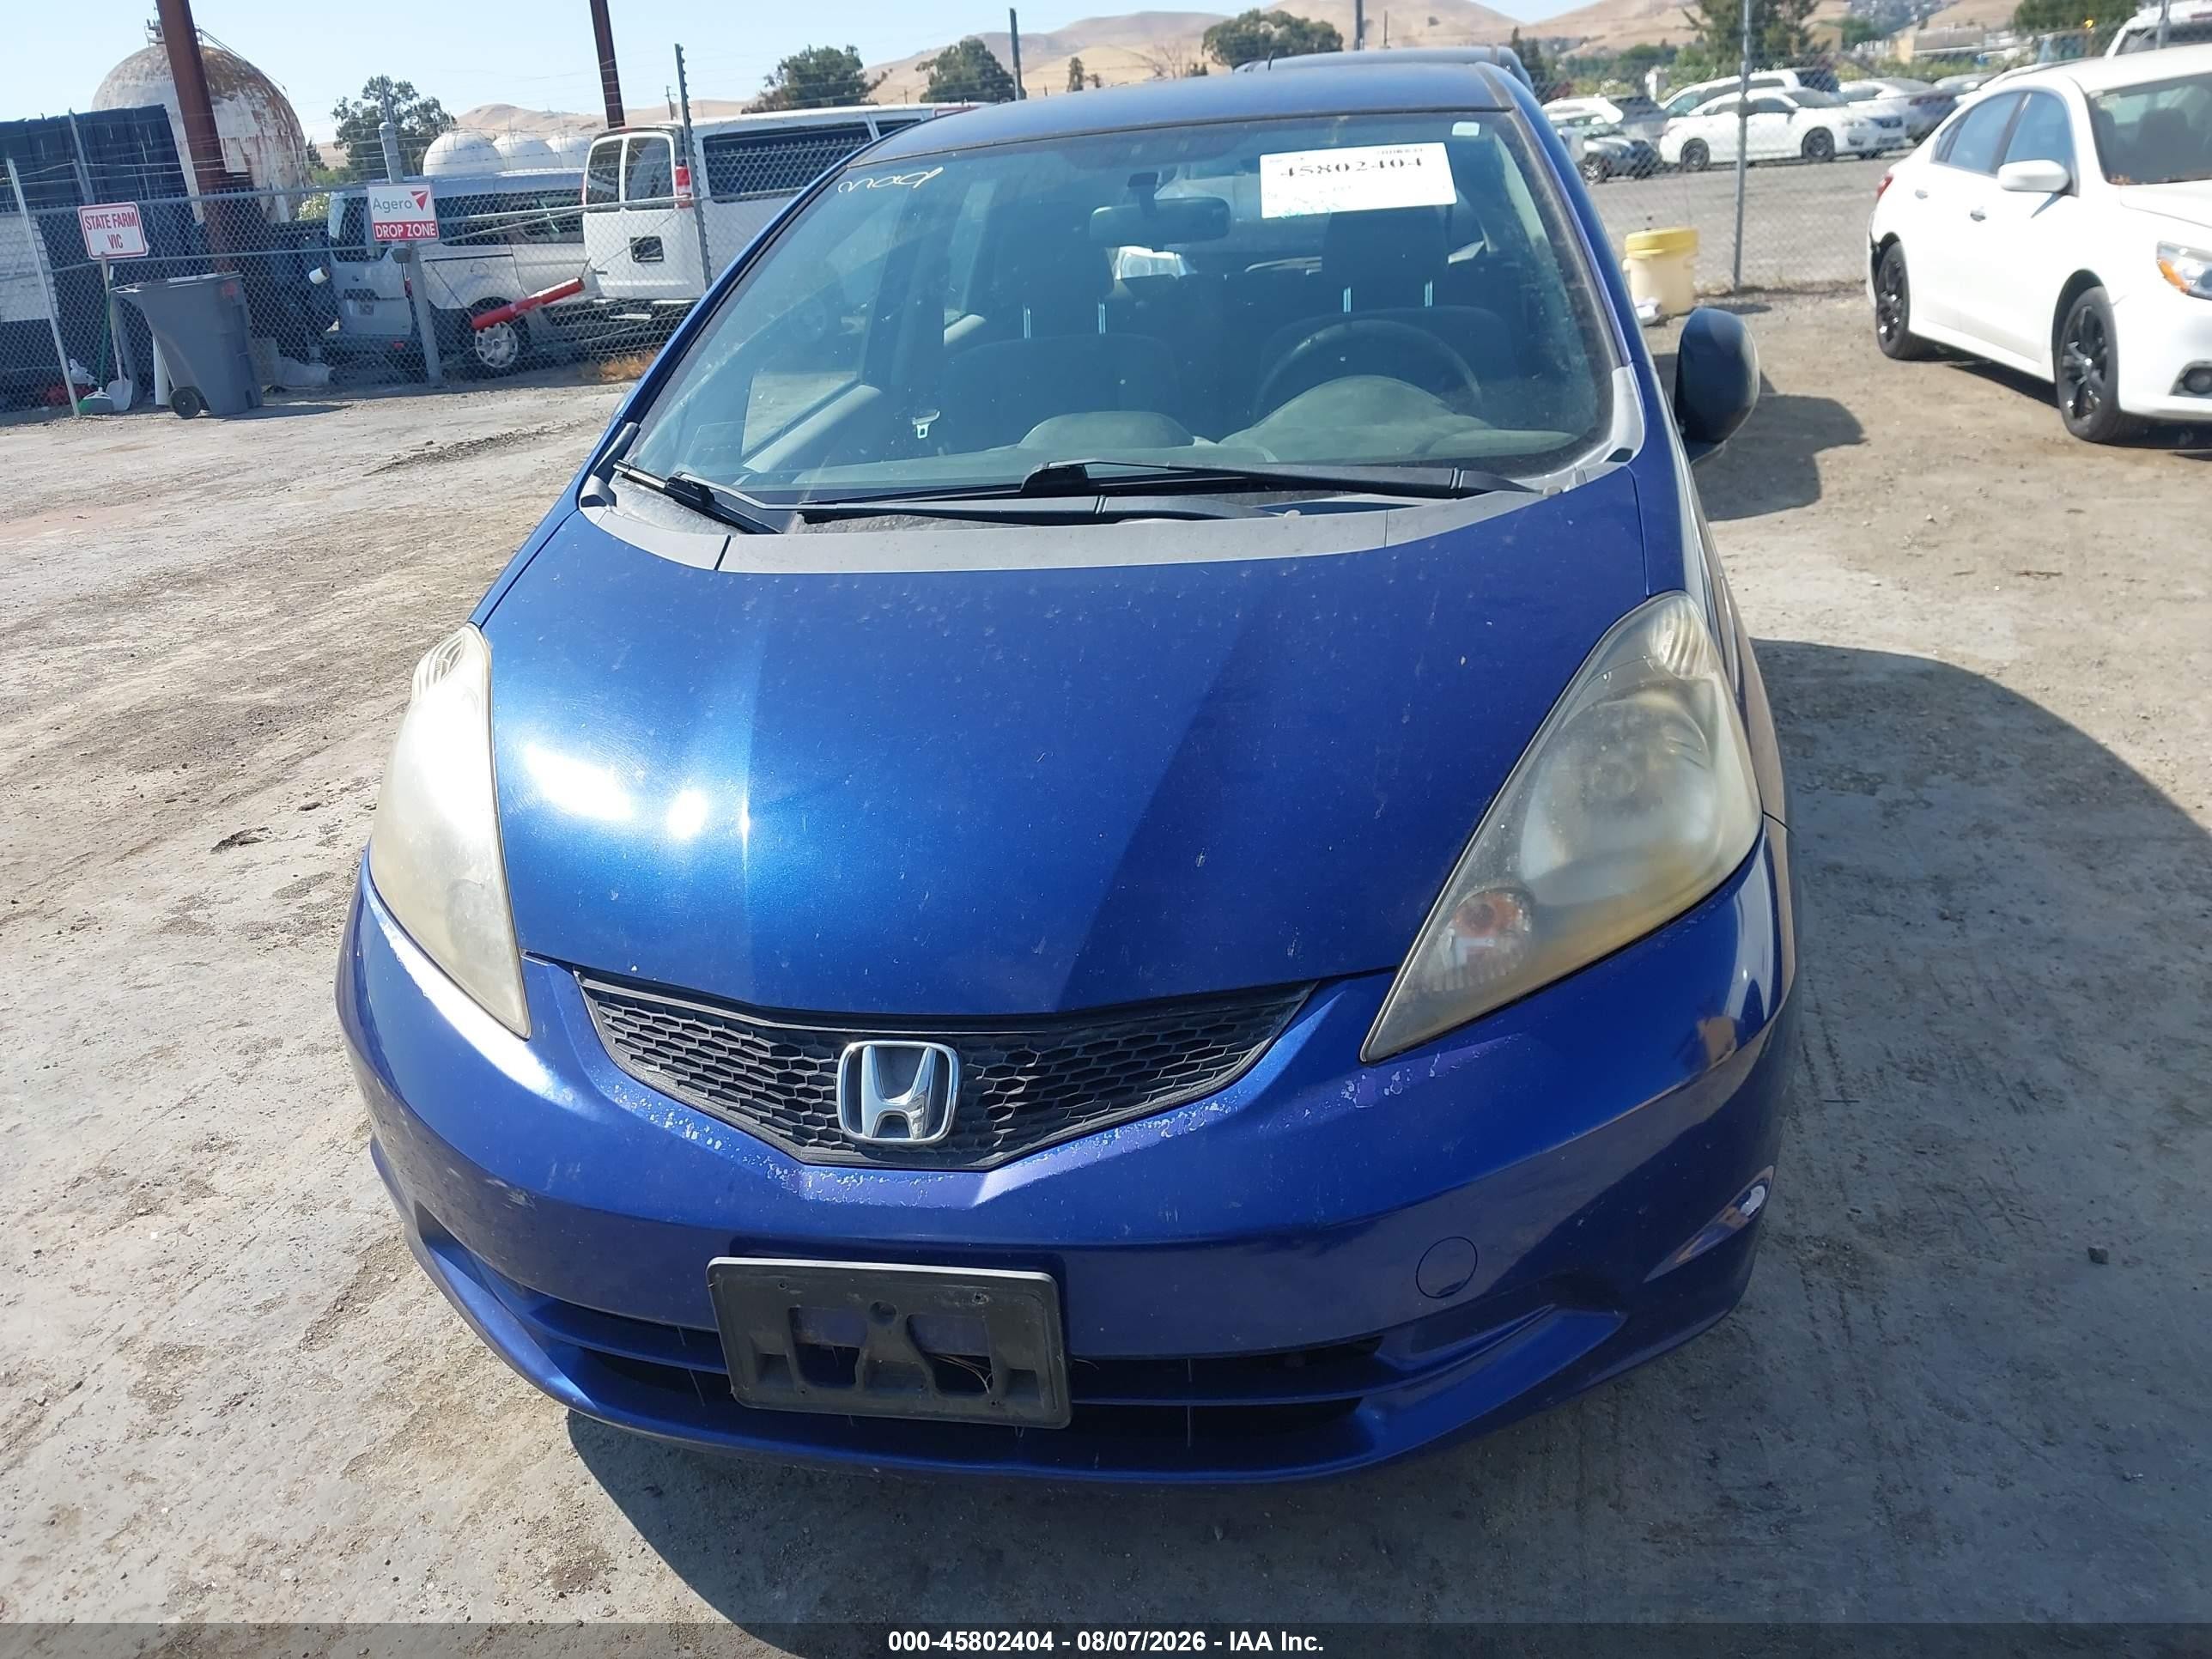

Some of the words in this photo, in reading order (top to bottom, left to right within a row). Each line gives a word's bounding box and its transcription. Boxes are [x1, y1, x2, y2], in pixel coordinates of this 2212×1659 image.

[373, 198, 412, 213] Agero
[84, 213, 112, 230] STATE
[112, 211, 137, 228] FARM
[374, 224, 404, 238] DROP
[406, 223, 435, 237] ZONE
[107, 234, 123, 249] VIC
